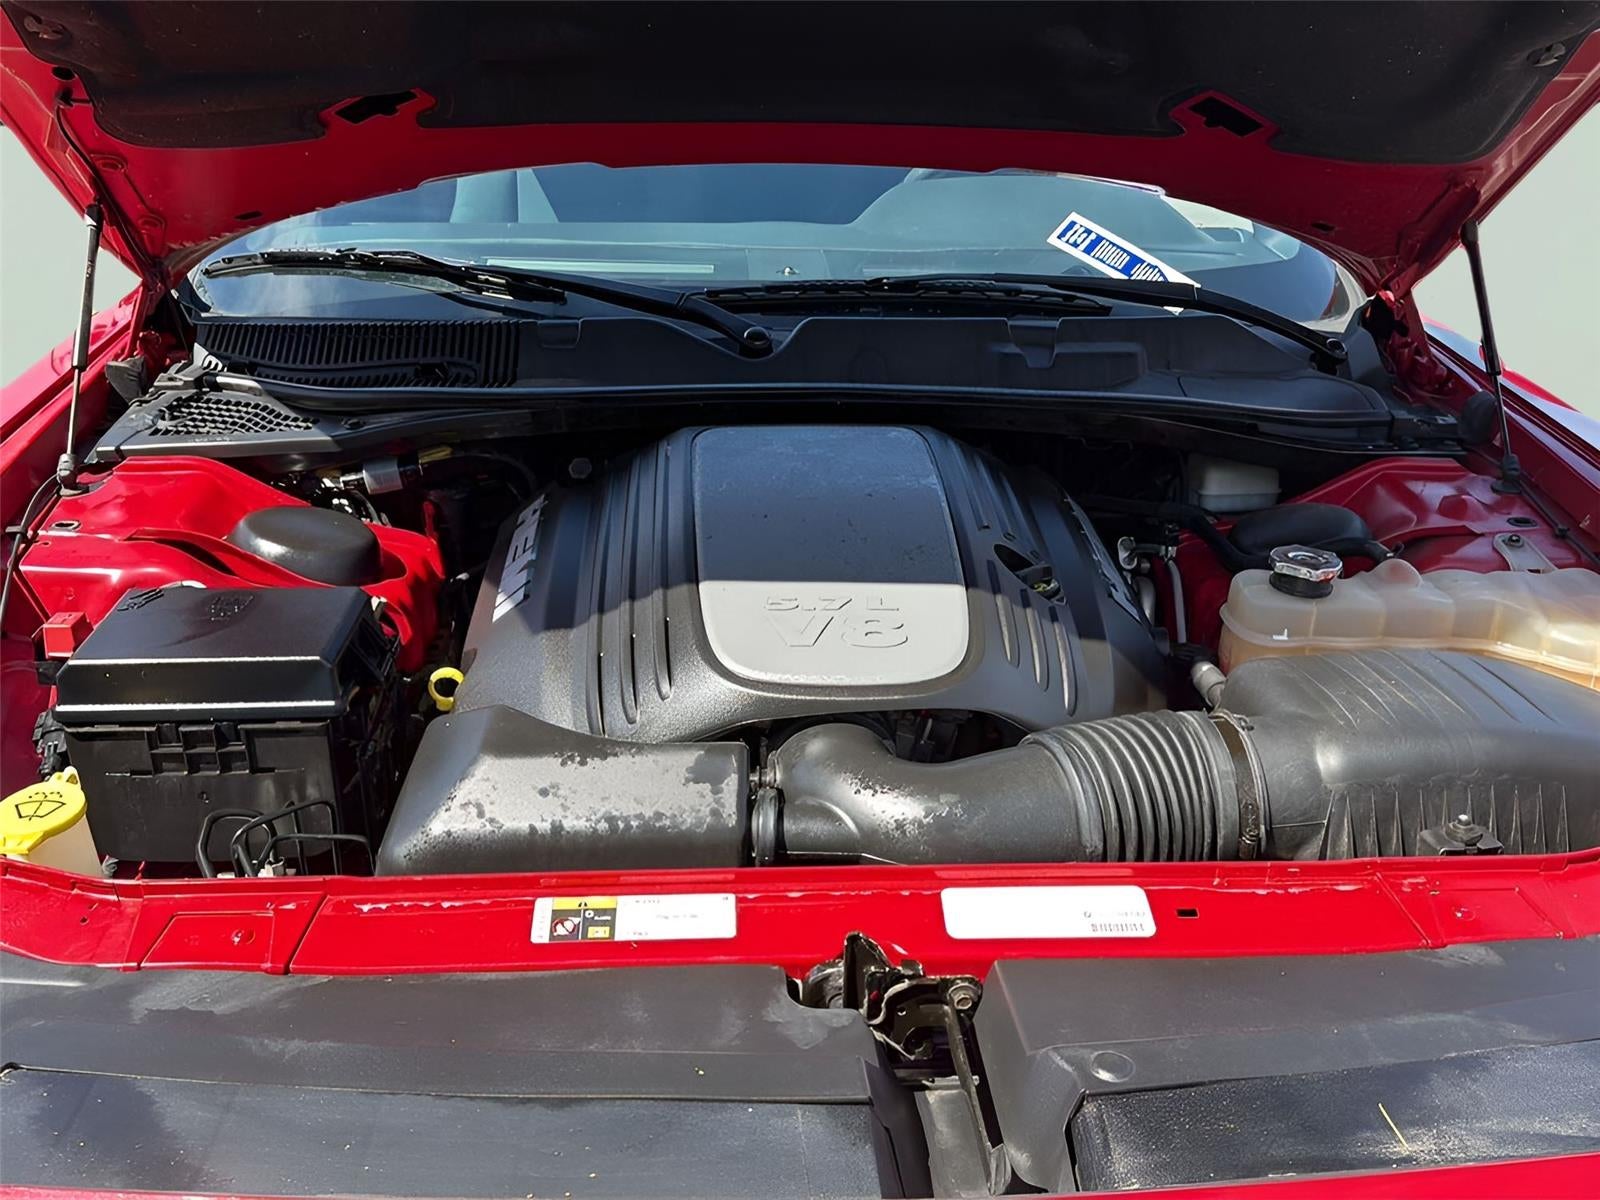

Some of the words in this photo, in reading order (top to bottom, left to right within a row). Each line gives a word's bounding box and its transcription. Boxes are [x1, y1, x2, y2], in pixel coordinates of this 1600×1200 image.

[491, 494, 547, 623] HEMI
[764, 596, 853, 612] 5.7
[866, 596, 900, 612] L
[767, 614, 909, 649] V8
